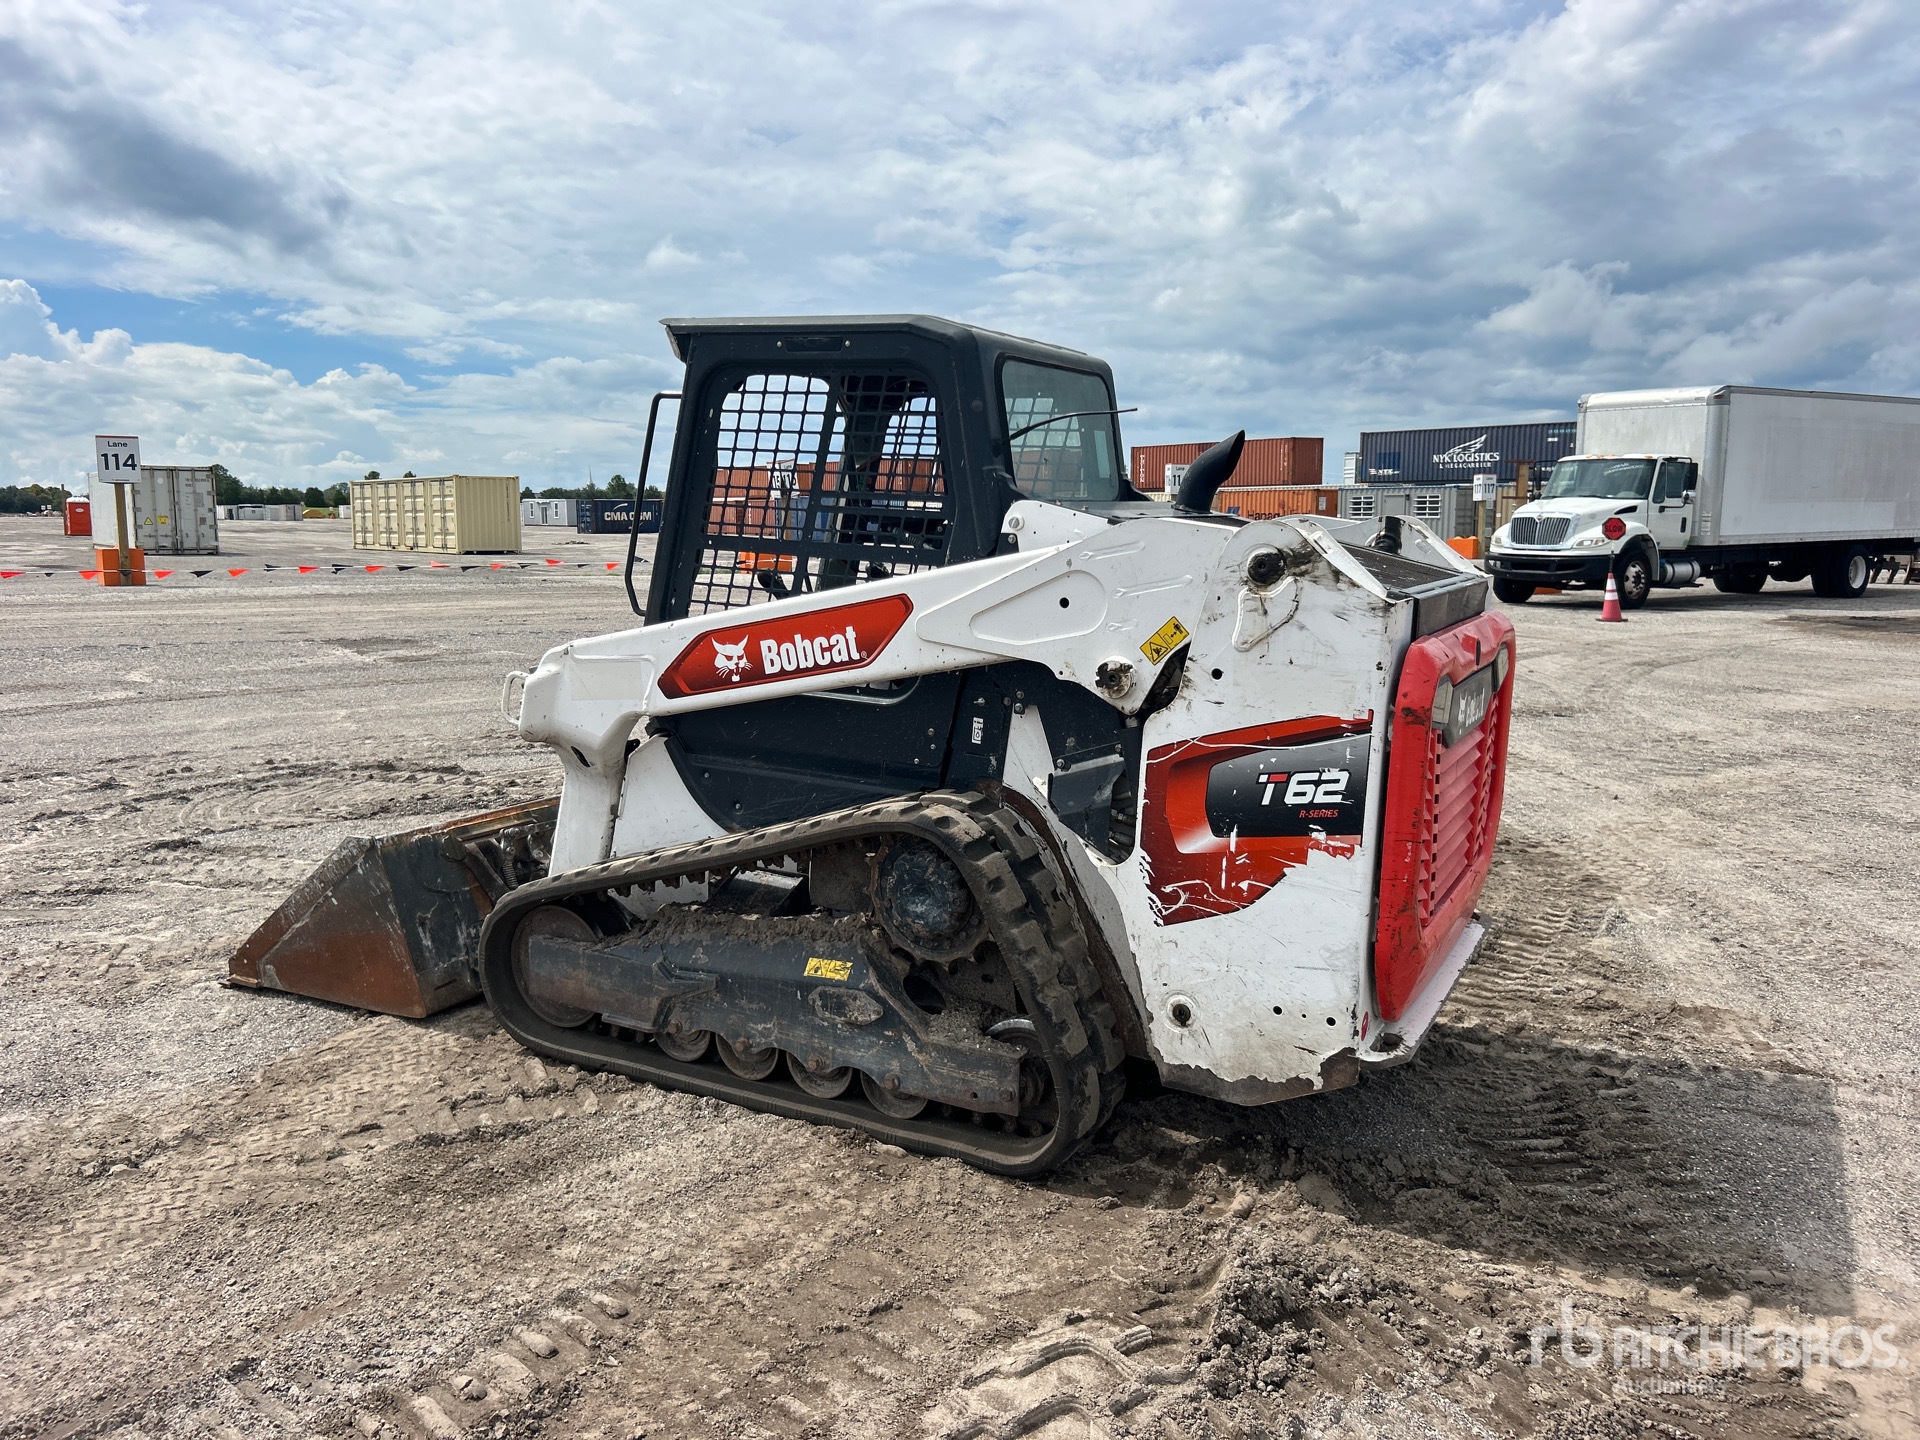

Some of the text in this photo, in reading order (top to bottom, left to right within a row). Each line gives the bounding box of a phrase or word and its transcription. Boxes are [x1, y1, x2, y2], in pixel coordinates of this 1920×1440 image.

[107, 440, 128, 448] Lane
[100, 453, 138, 471] 114
[1433, 452, 1500, 463] NYK LOGISTICS
[1484, 483, 1496, 494] 117
[604, 511, 628, 521] CMA
[1604, 524, 1623, 533] SLOW
[760, 626, 860, 675] Bobcat
[1258, 770, 1350, 806] T62
[1299, 808, 1339, 818] R-SERIES
